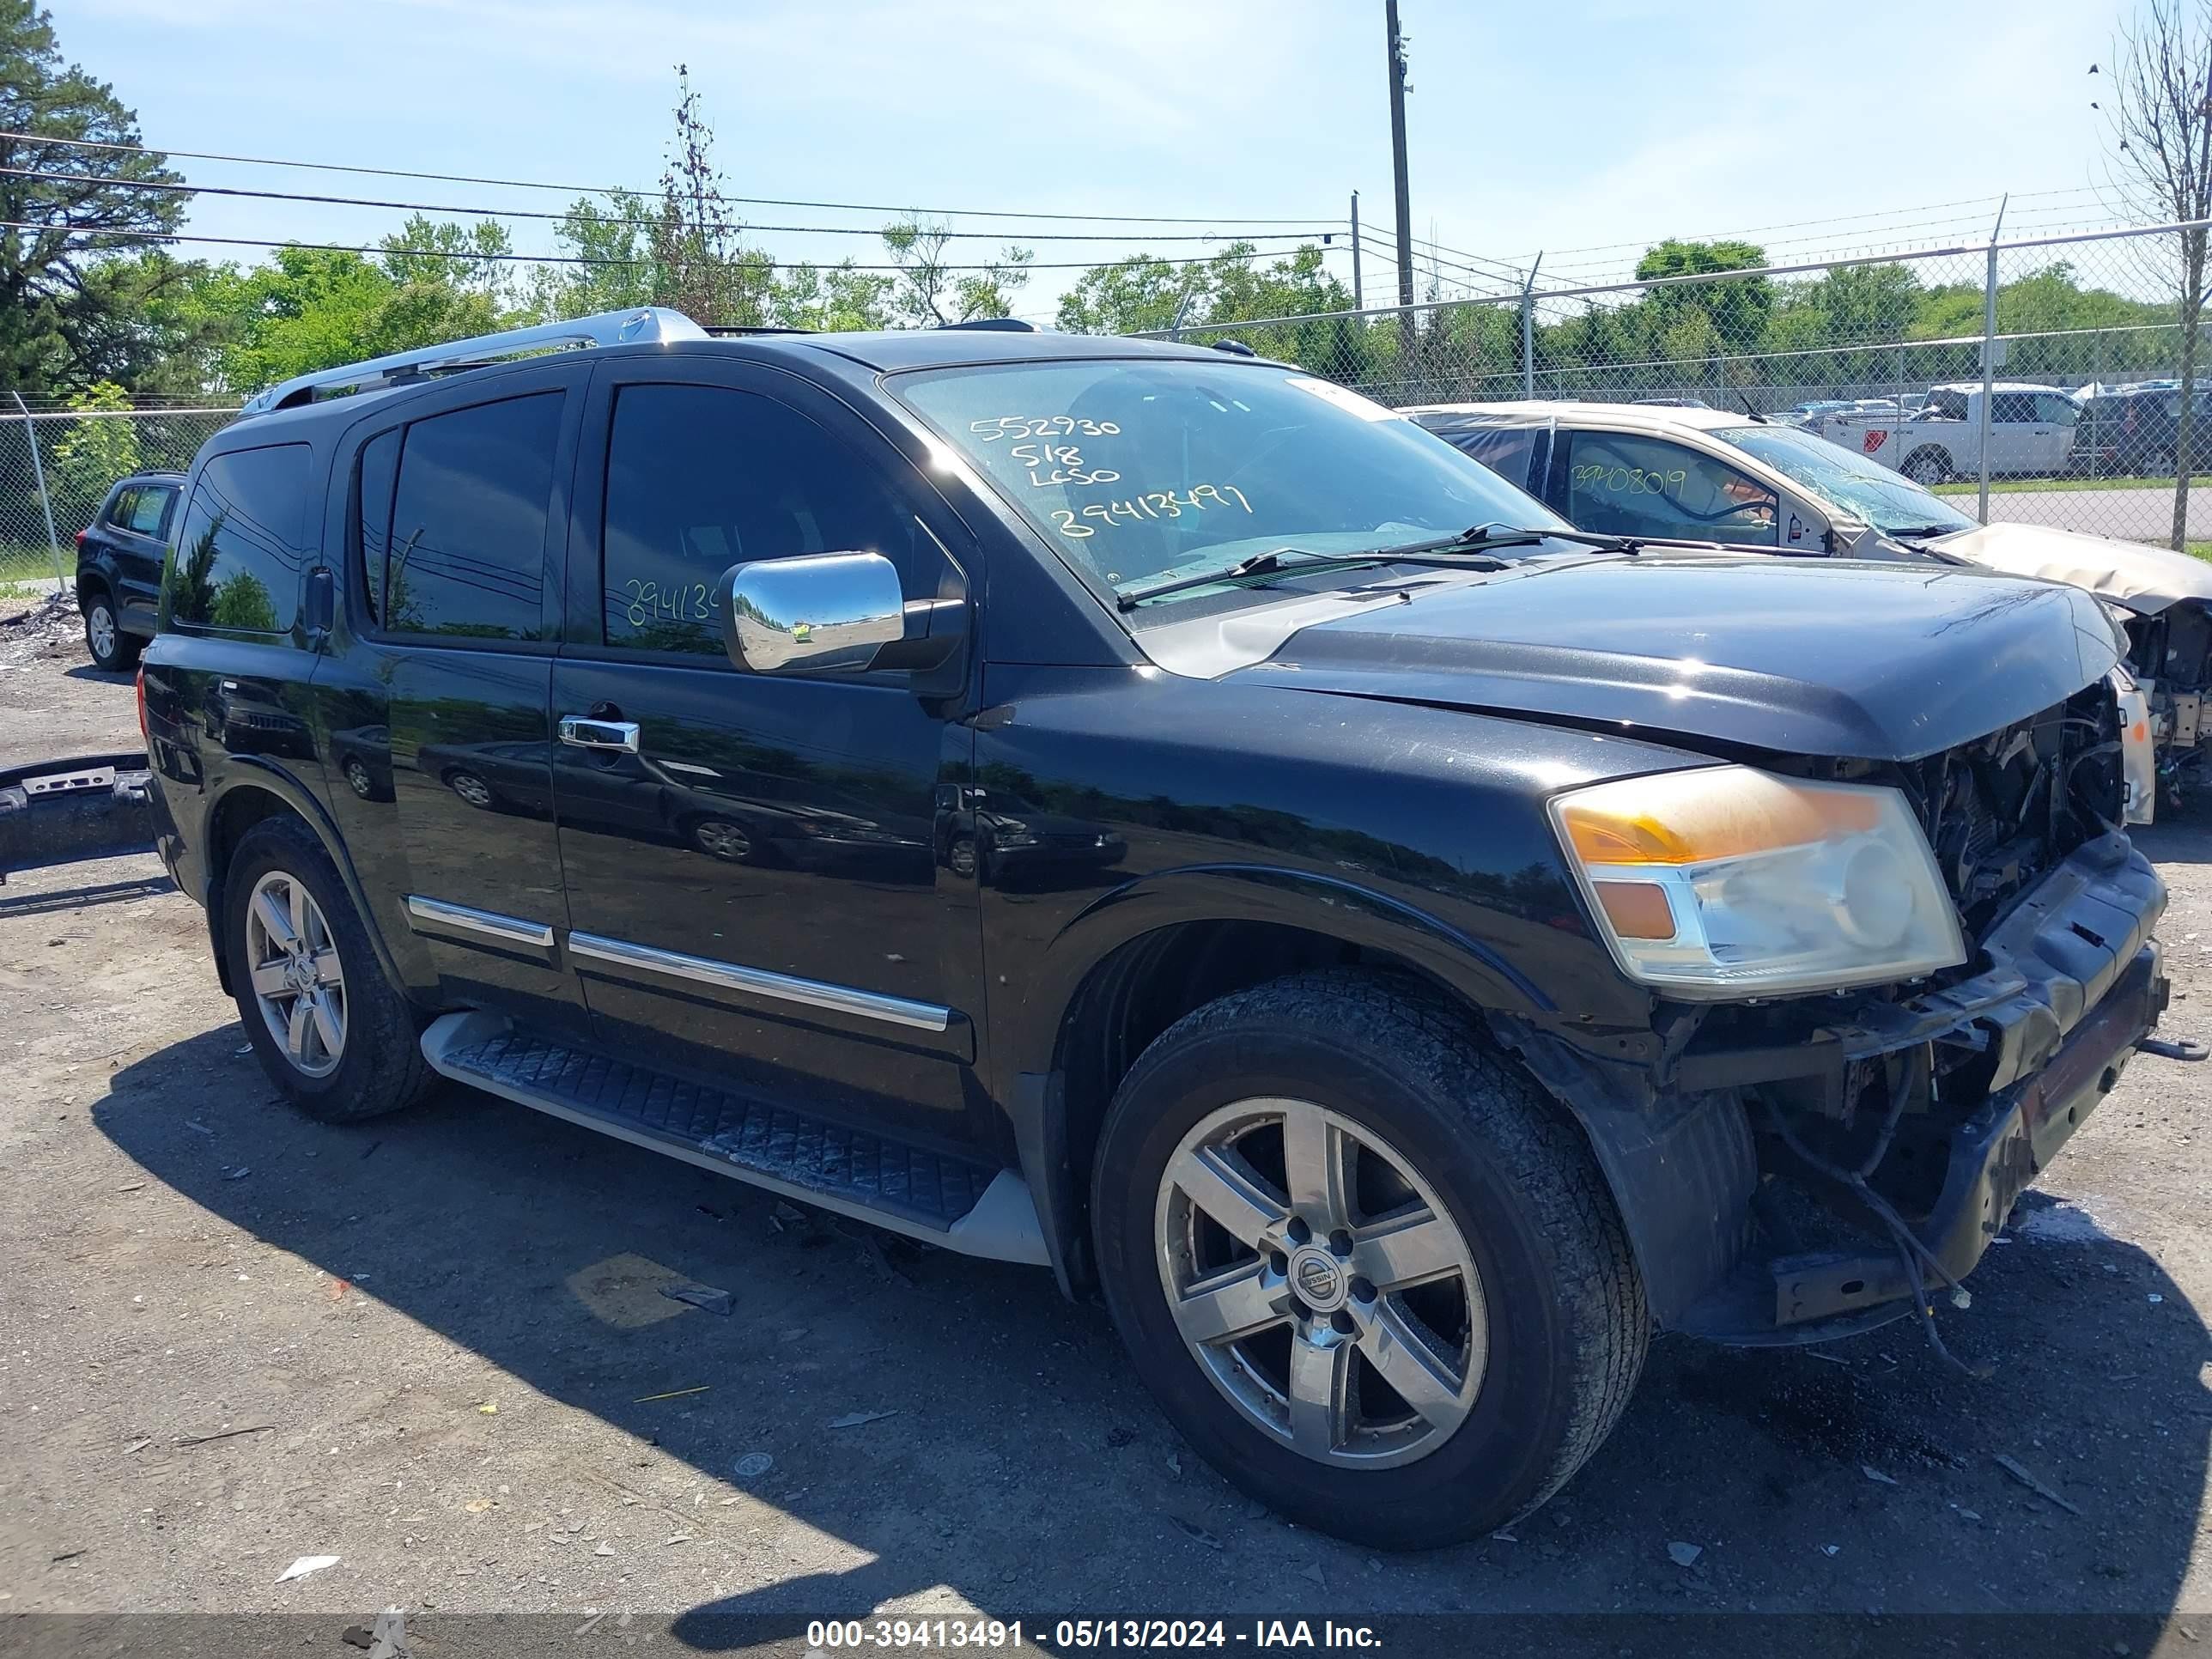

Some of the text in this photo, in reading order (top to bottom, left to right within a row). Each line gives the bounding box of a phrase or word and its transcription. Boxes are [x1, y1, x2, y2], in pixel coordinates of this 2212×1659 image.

[970, 416, 1120, 442] 552930
[1011, 444, 1085, 467] 518
[1571, 465, 1686, 501] 39408019
